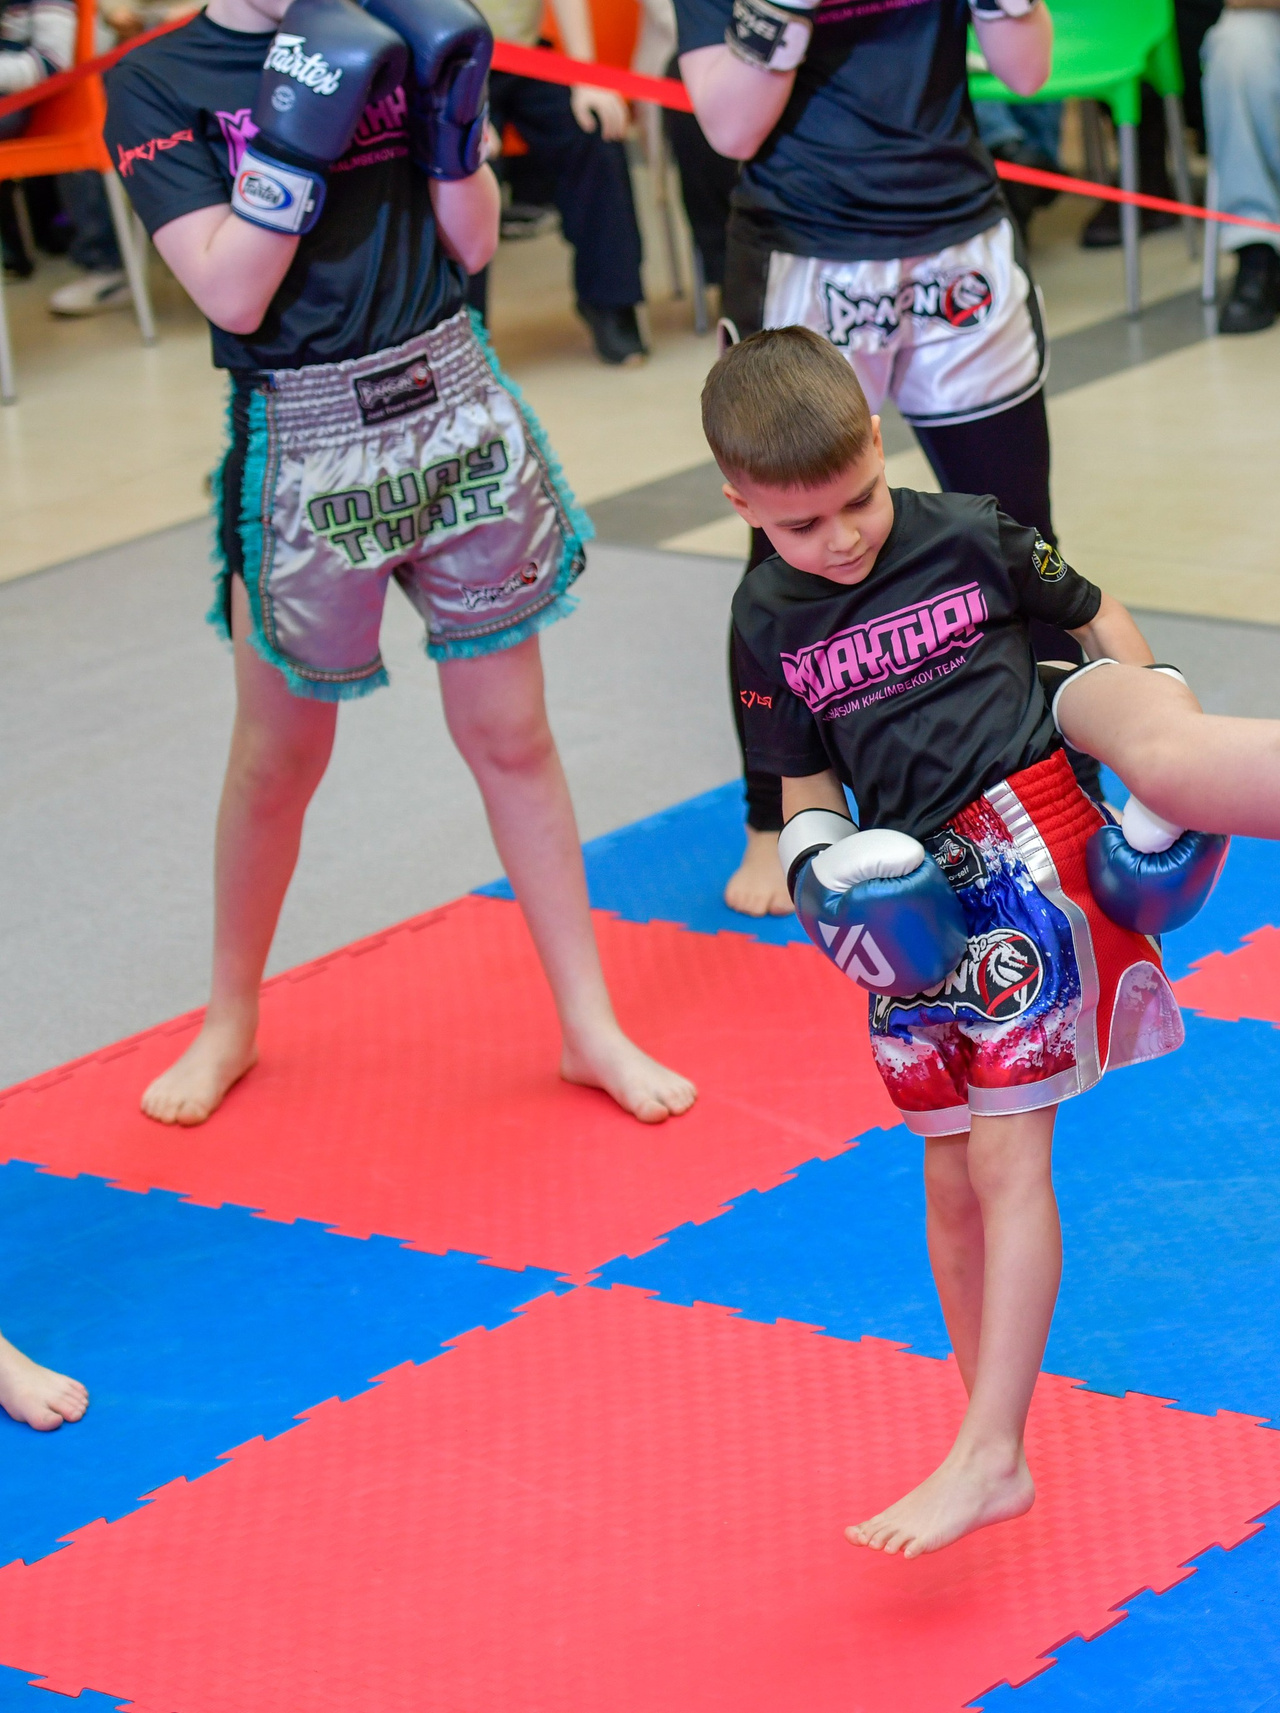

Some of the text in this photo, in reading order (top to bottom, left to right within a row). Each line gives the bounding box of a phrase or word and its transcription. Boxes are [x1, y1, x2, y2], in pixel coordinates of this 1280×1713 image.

[263, 33, 342, 95] Fairtex
[243, 177, 281, 204] Fairtex
[308, 440, 510, 531] MUAY
[331, 482, 505, 565] THAI
[862, 671, 934, 707] KHALIMBEKOV
[935, 655, 967, 677] TEAM
